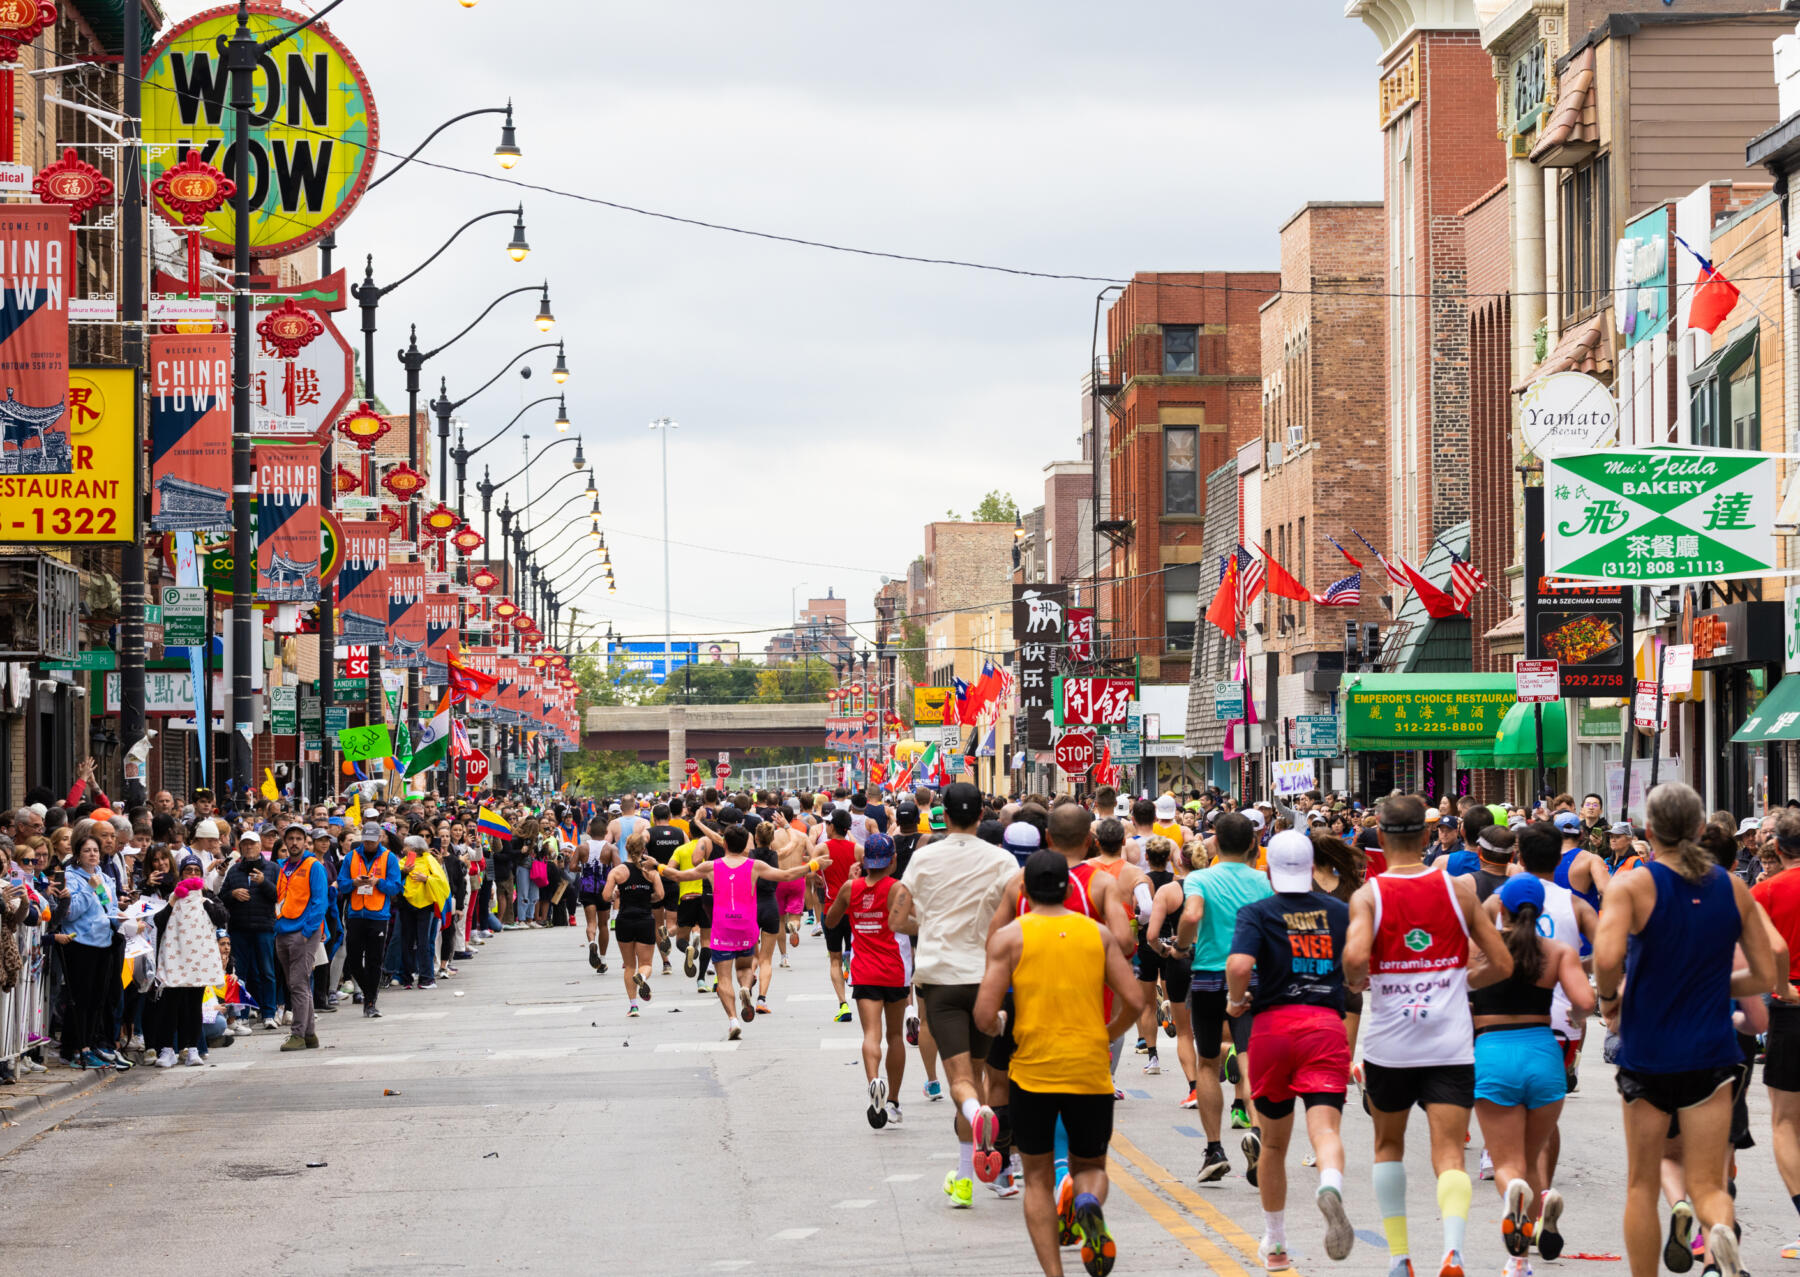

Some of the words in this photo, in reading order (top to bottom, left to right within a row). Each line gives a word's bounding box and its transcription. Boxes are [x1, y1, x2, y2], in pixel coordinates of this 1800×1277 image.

[169, 51, 329, 127] WON
[38, 222, 49, 230] TO
[157, 360, 226, 386] CHINA
[157, 386, 227, 412] TOWN
[1529, 408, 1611, 426] Yamato
[1551, 427, 1590, 438] Beauty
[72, 445, 94, 469] R
[261, 465, 317, 486] CHINA
[1603, 460, 1647, 475] Mui's
[1648, 455, 1719, 480] Feida
[261, 486, 317, 507] TOWN
[1622, 480, 1707, 495] BAKERY
[1626, 534, 1700, 558] 茶餐廳
[1602, 562, 1642, 577] (312)
[1646, 561, 1675, 574] 808
[1354, 693, 1412, 704] EMPEROR'S
[1416, 693, 1453, 704] CHOICE
[1394, 722, 1484, 732] 312-225-8800
[352, 728, 380, 757] Todd
[944, 737, 958, 746] 25
[1058, 746, 1093, 762] STOP
[1282, 909, 1329, 930] DON'T
[1288, 934, 1334, 959] EVER
[1292, 957, 1316, 974] GIVE
[1380, 955, 1460, 970] terramia.com
[1382, 983, 1412, 995] MAX
